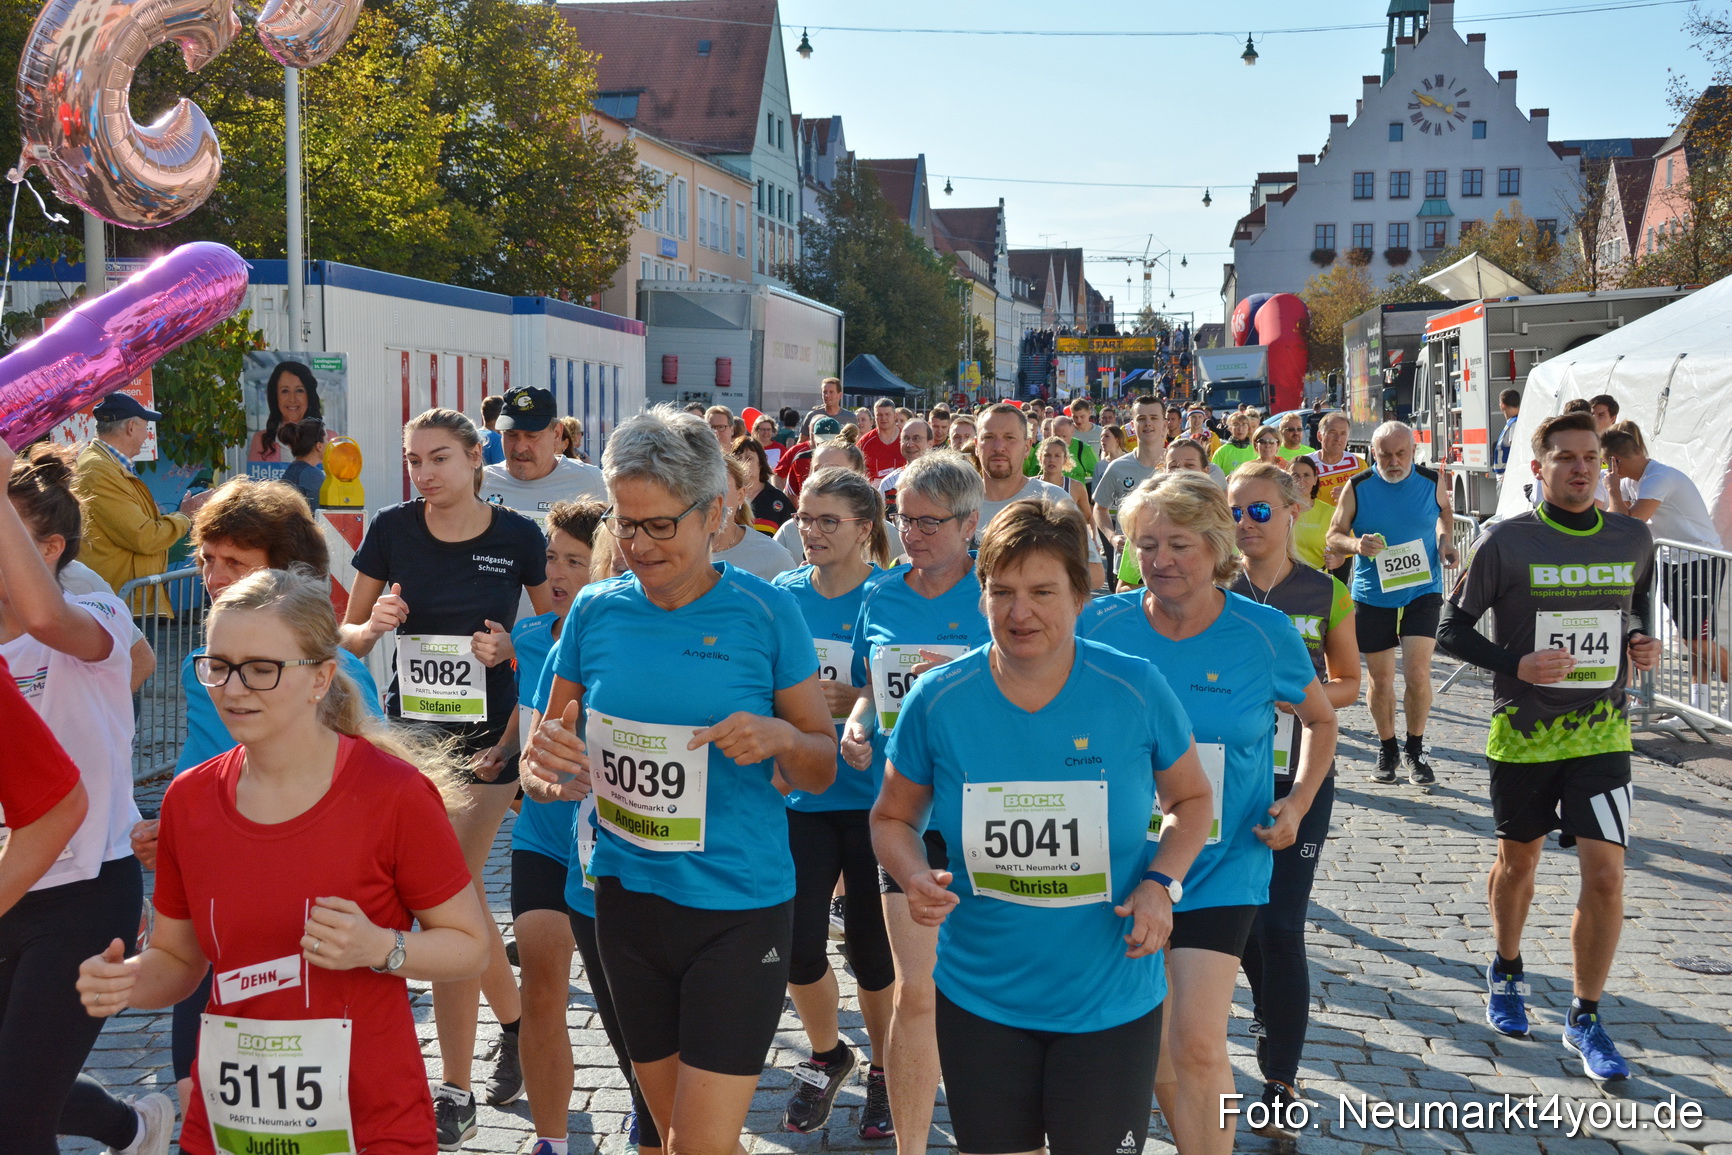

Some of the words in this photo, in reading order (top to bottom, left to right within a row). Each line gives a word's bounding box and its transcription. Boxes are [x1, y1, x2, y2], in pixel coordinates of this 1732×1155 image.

[1088, 340, 1123, 350] START
[472, 554, 514, 567] Landgasthof
[1384, 553, 1421, 573] 5208
[478, 564, 507, 574] Schnaus
[1529, 562, 1636, 588] BOCK
[1530, 588, 1565, 598] inspired
[1566, 588, 1577, 598] by
[1578, 588, 1602, 596] smart
[1103, 603, 1118, 613] JAKO
[1562, 617, 1598, 626] BOCK
[936, 634, 968, 642] Gerlinde
[1549, 632, 1609, 656] 5144
[420, 643, 459, 654] BOCK
[682, 647, 730, 662] Angelika
[410, 659, 472, 686] 5082
[945, 667, 962, 680] JAKO
[1190, 683, 1232, 695] Marianne
[419, 699, 462, 712] Stefanie
[612, 729, 668, 750] BOCK
[1064, 755, 1103, 767] Christa
[601, 748, 686, 800] 5039
[611, 790, 629, 806] PARTL
[628, 799, 665, 813] Neumarkt
[1003, 793, 1065, 808] BOCK
[615, 808, 670, 838] Angelika
[984, 818, 1080, 859] 5041
[995, 863, 1025, 872] PARTL
[1026, 863, 1068, 872] Neumarkt
[1009, 878, 1069, 895] Christa
[240, 969, 278, 991] DEHN
[237, 1032, 303, 1052] BOCK
[219, 1060, 323, 1111] 5115
[229, 1113, 257, 1125] PARTL
[258, 1116, 302, 1128] Neumarkt
[245, 1136, 300, 1155] Judith
